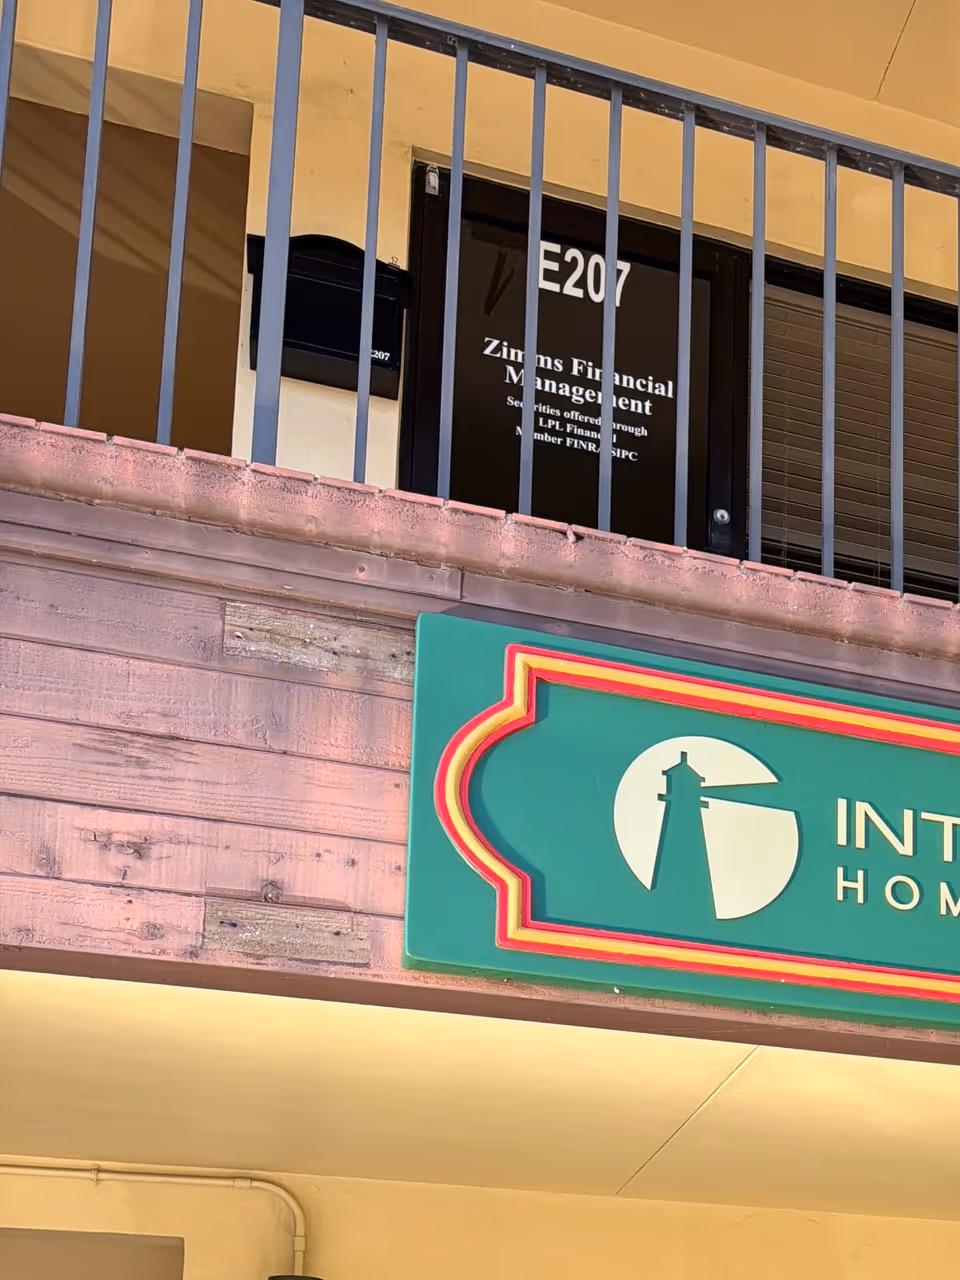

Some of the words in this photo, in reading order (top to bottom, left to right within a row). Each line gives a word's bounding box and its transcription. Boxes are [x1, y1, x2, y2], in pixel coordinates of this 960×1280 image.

[538, 240, 631, 308] E207
[371, 350, 390, 361] 207
[538, 416, 564, 431] LPL
[563, 410, 602, 426] offered
